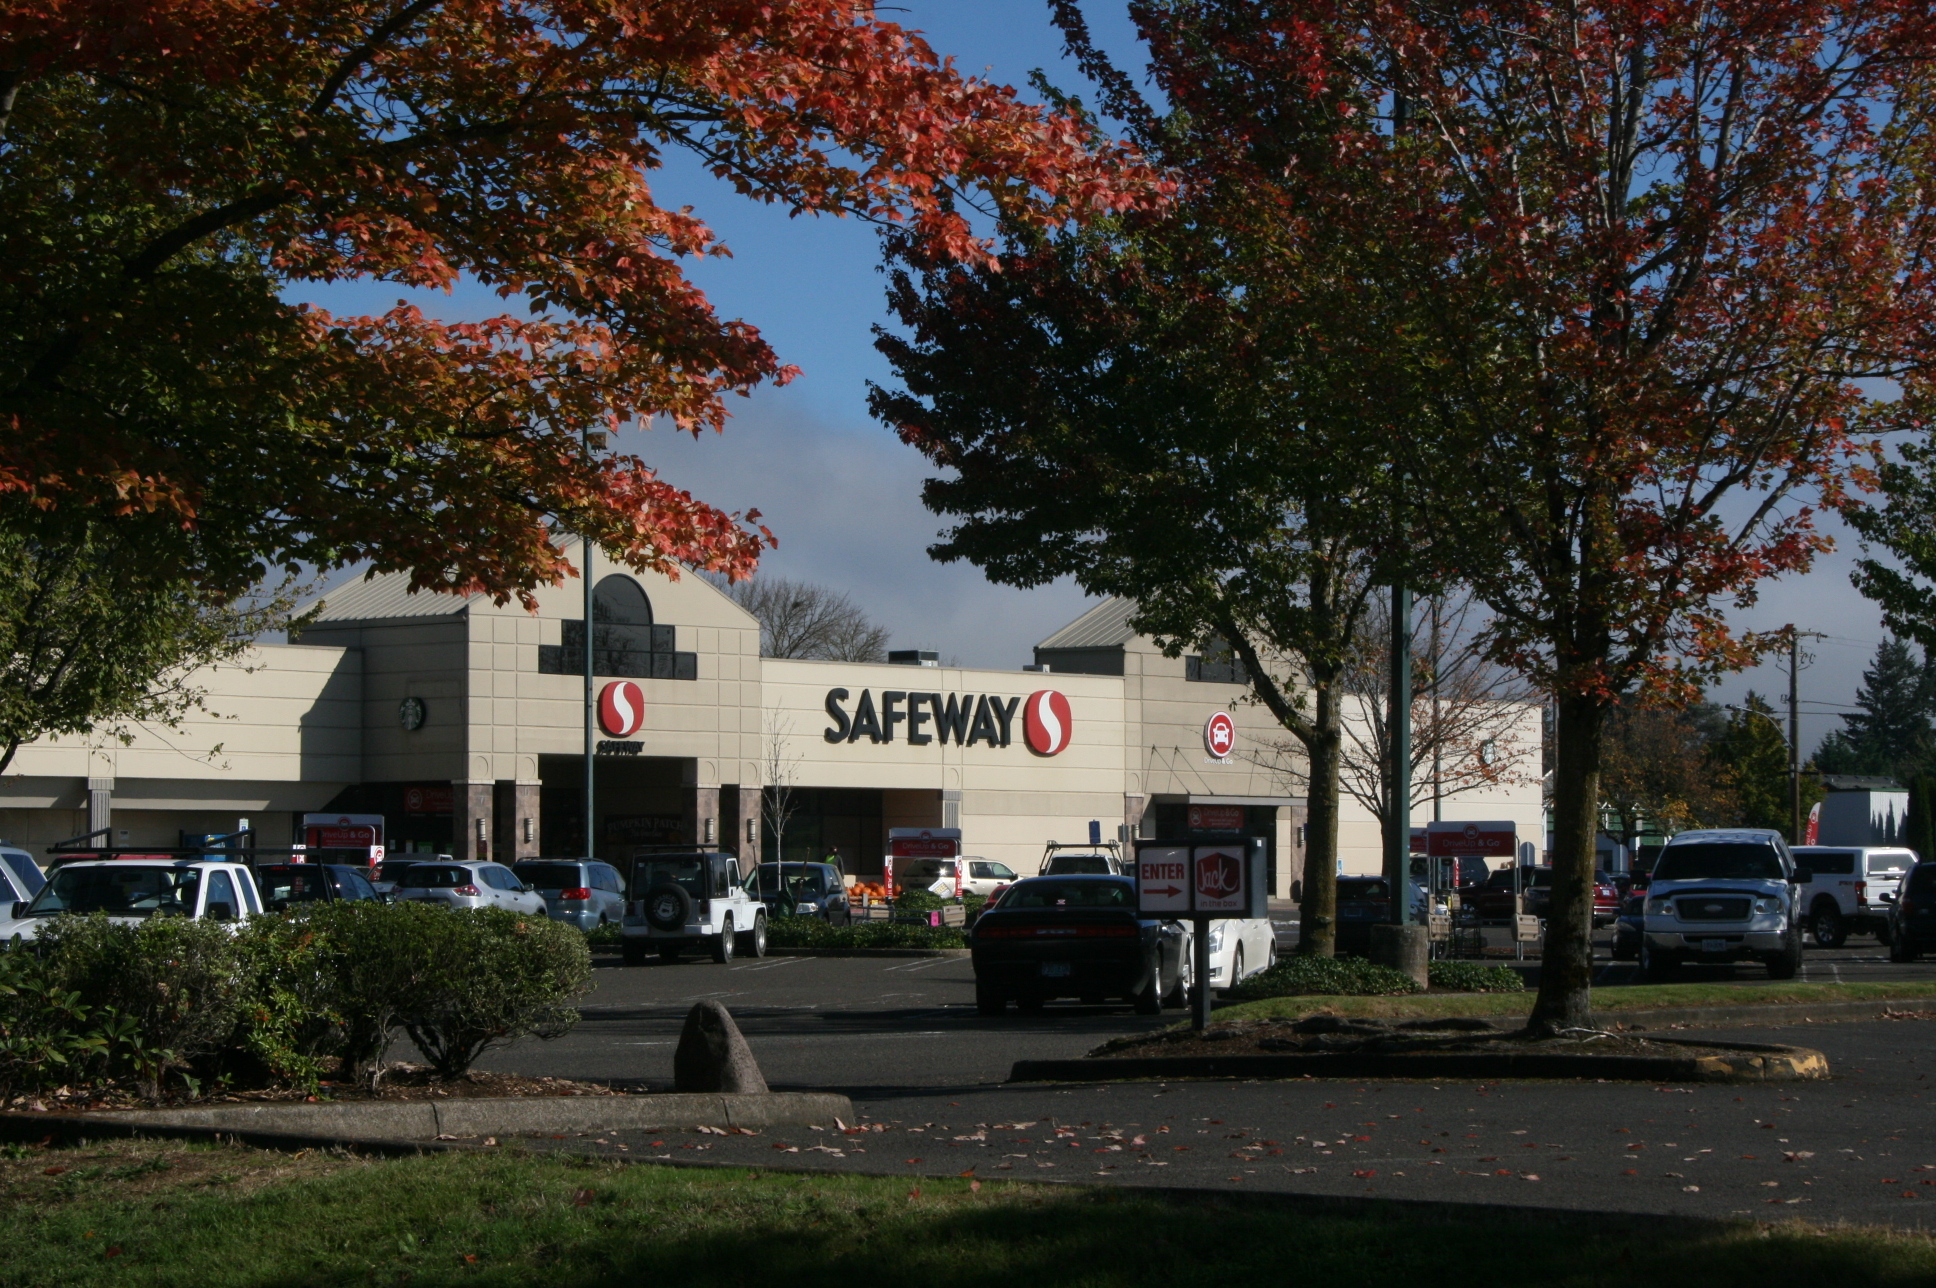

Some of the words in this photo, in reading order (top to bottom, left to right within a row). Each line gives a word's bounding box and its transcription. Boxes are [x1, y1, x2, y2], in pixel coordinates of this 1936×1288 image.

[824, 687, 1021, 748] SAFEWAY
[597, 740, 645, 754] SAFEWAY
[358, 831, 370, 839] Go
[1442, 839, 1476, 848] DriveUp
[1477, 839, 1485, 847] &
[1486, 839, 1500, 847] Go
[1141, 863, 1185, 880] ENTER
[1197, 858, 1239, 892] Jack
